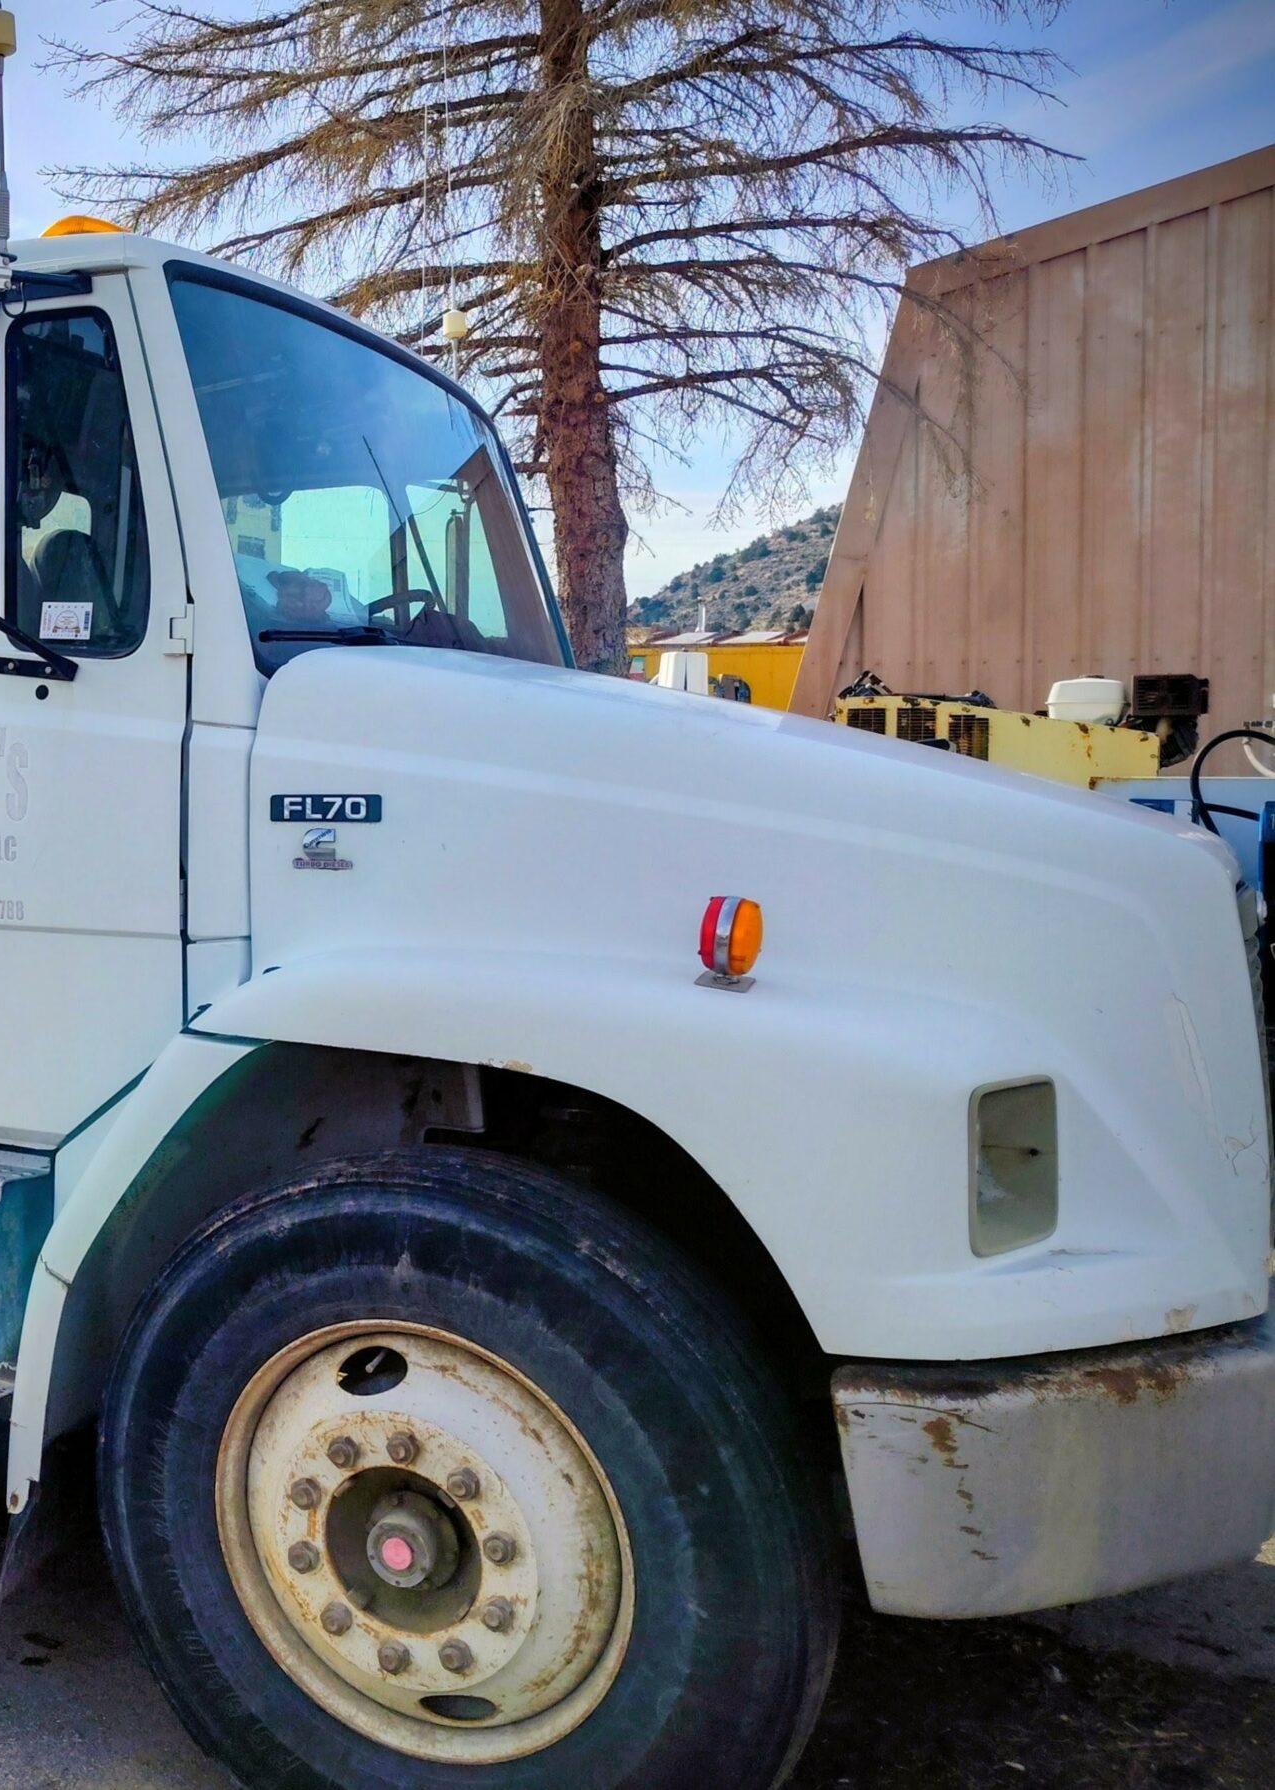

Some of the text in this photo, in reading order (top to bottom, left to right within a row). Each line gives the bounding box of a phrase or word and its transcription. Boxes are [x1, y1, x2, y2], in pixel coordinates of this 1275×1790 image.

[283, 797, 367, 820] FL70
[295, 860, 350, 868] TURBO DIESEL
